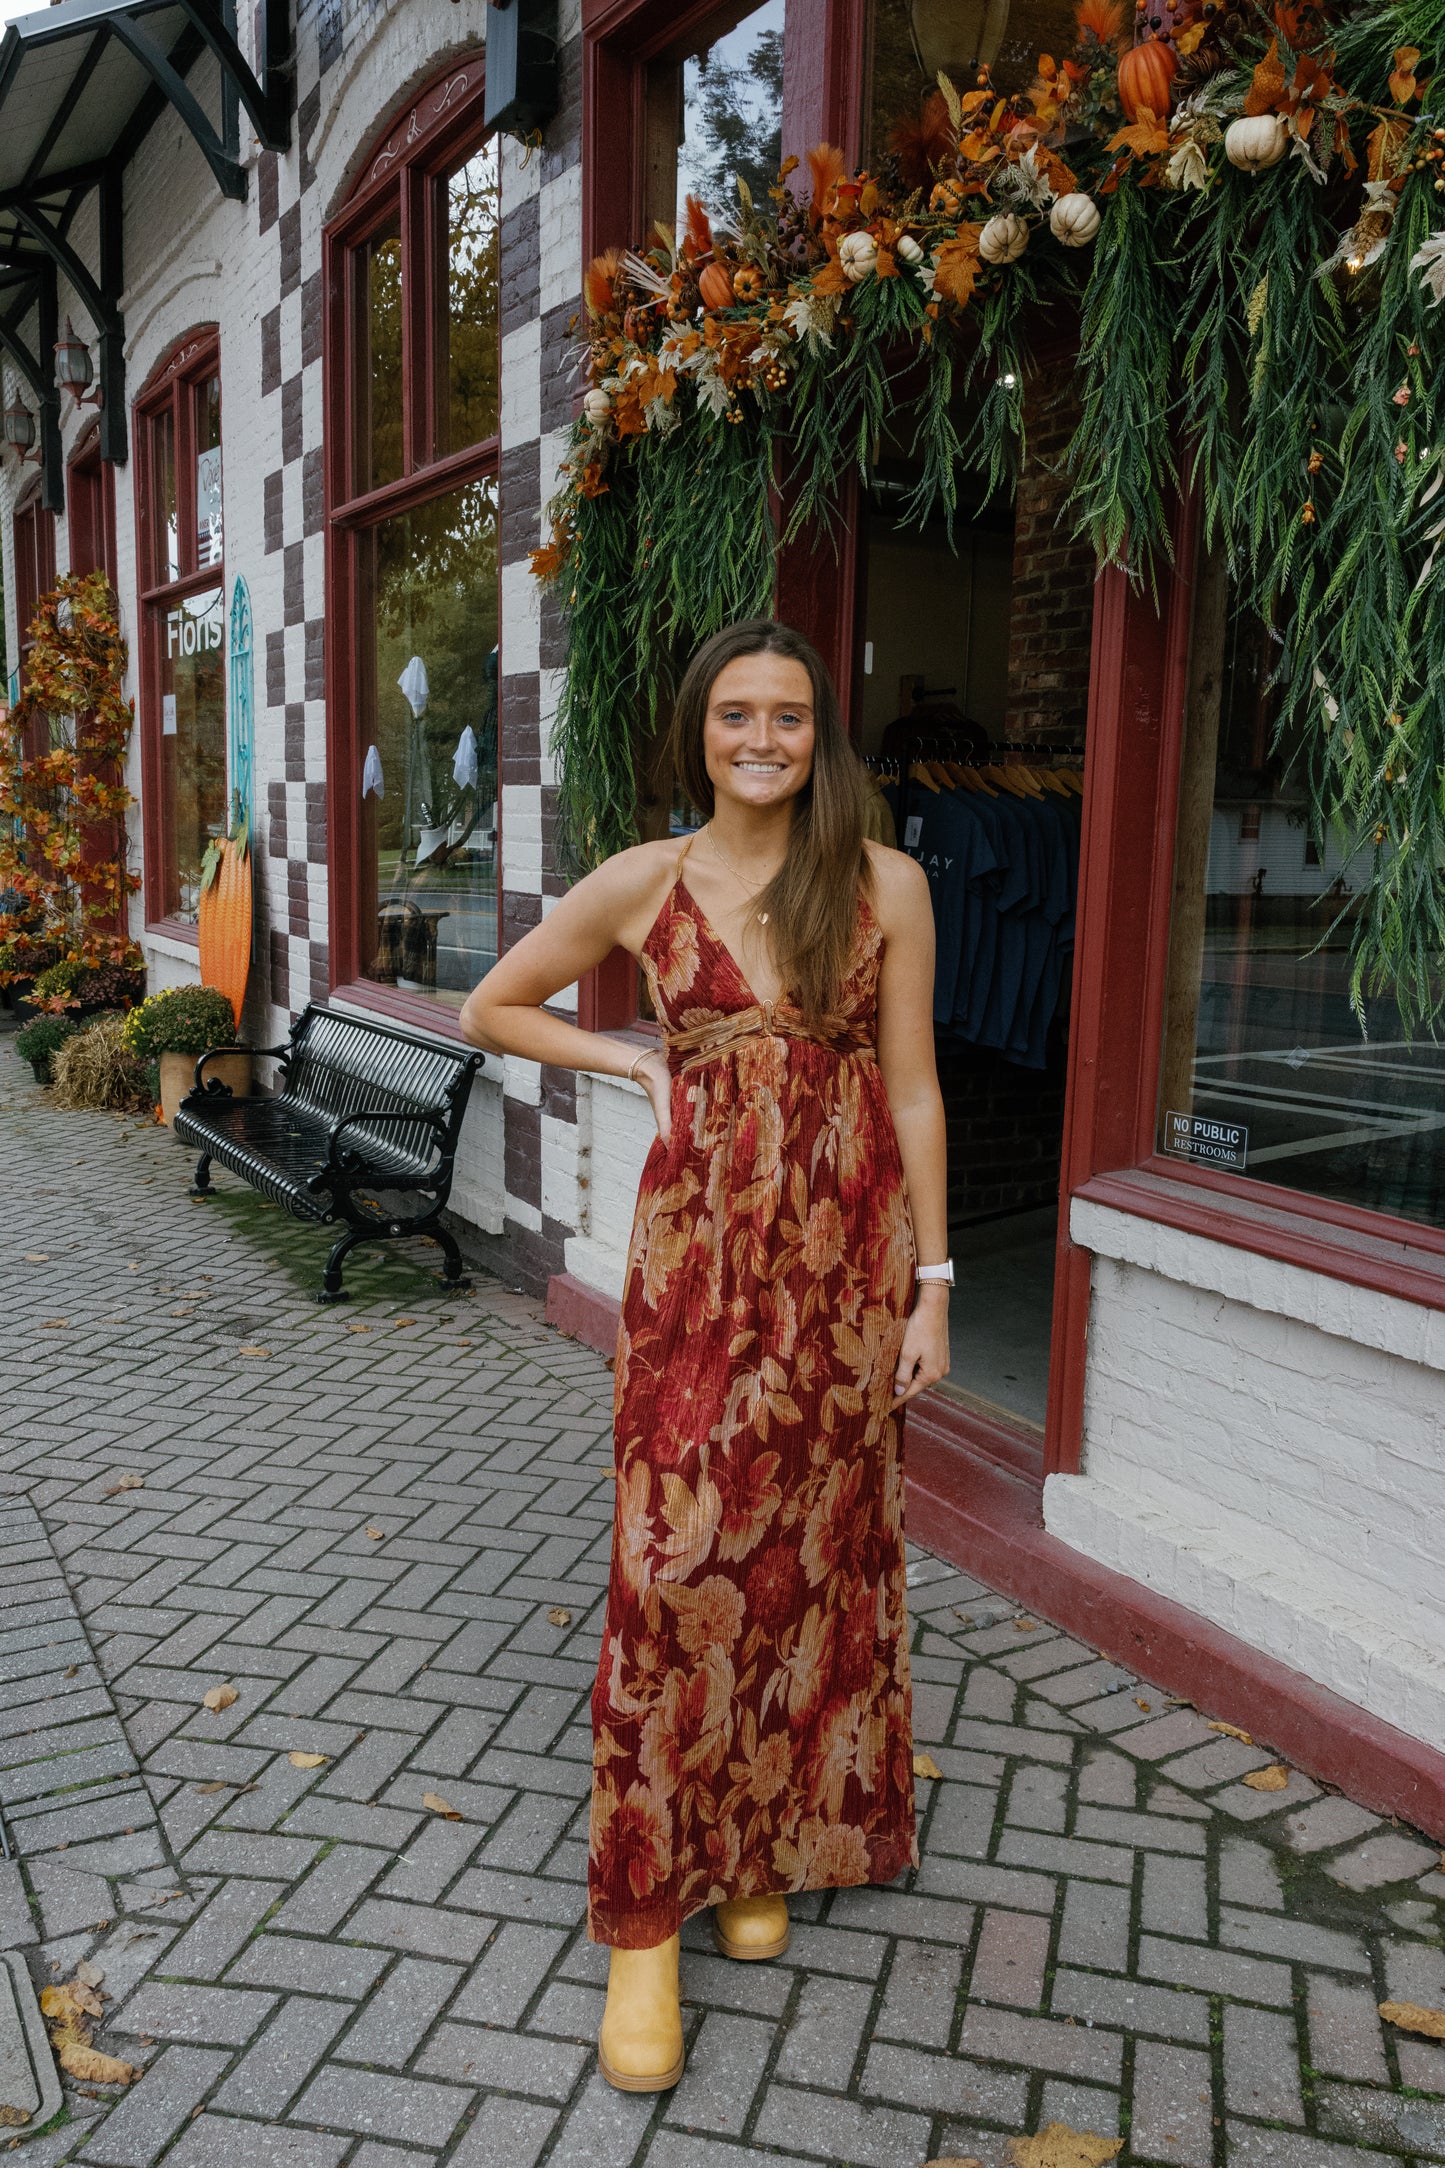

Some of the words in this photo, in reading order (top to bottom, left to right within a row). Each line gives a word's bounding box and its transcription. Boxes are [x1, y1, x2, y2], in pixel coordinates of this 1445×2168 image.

[1173, 1117, 1189, 1132] NO
[1194, 1121, 1240, 1144] PUBLIC
[1174, 1137, 1237, 1161] RESTROOMS
